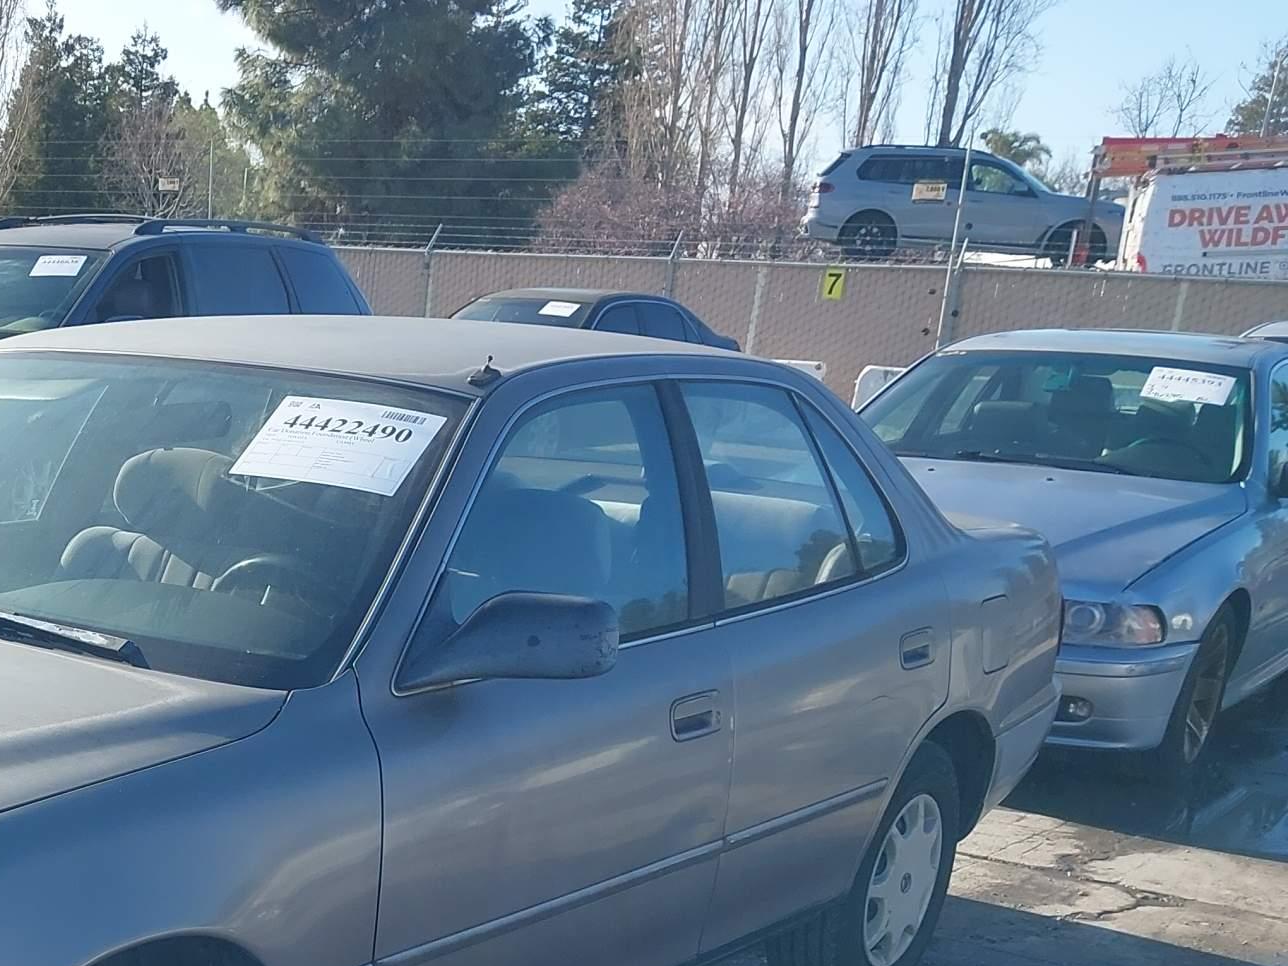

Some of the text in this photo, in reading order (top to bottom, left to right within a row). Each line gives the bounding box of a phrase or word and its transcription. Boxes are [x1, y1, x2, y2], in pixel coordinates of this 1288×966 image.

[1168, 207, 1250, 227] DRIVE
[1161, 261, 1271, 276] FRONTLINE
[827, 272, 843, 296] 7
[283, 414, 413, 443] 44422490
